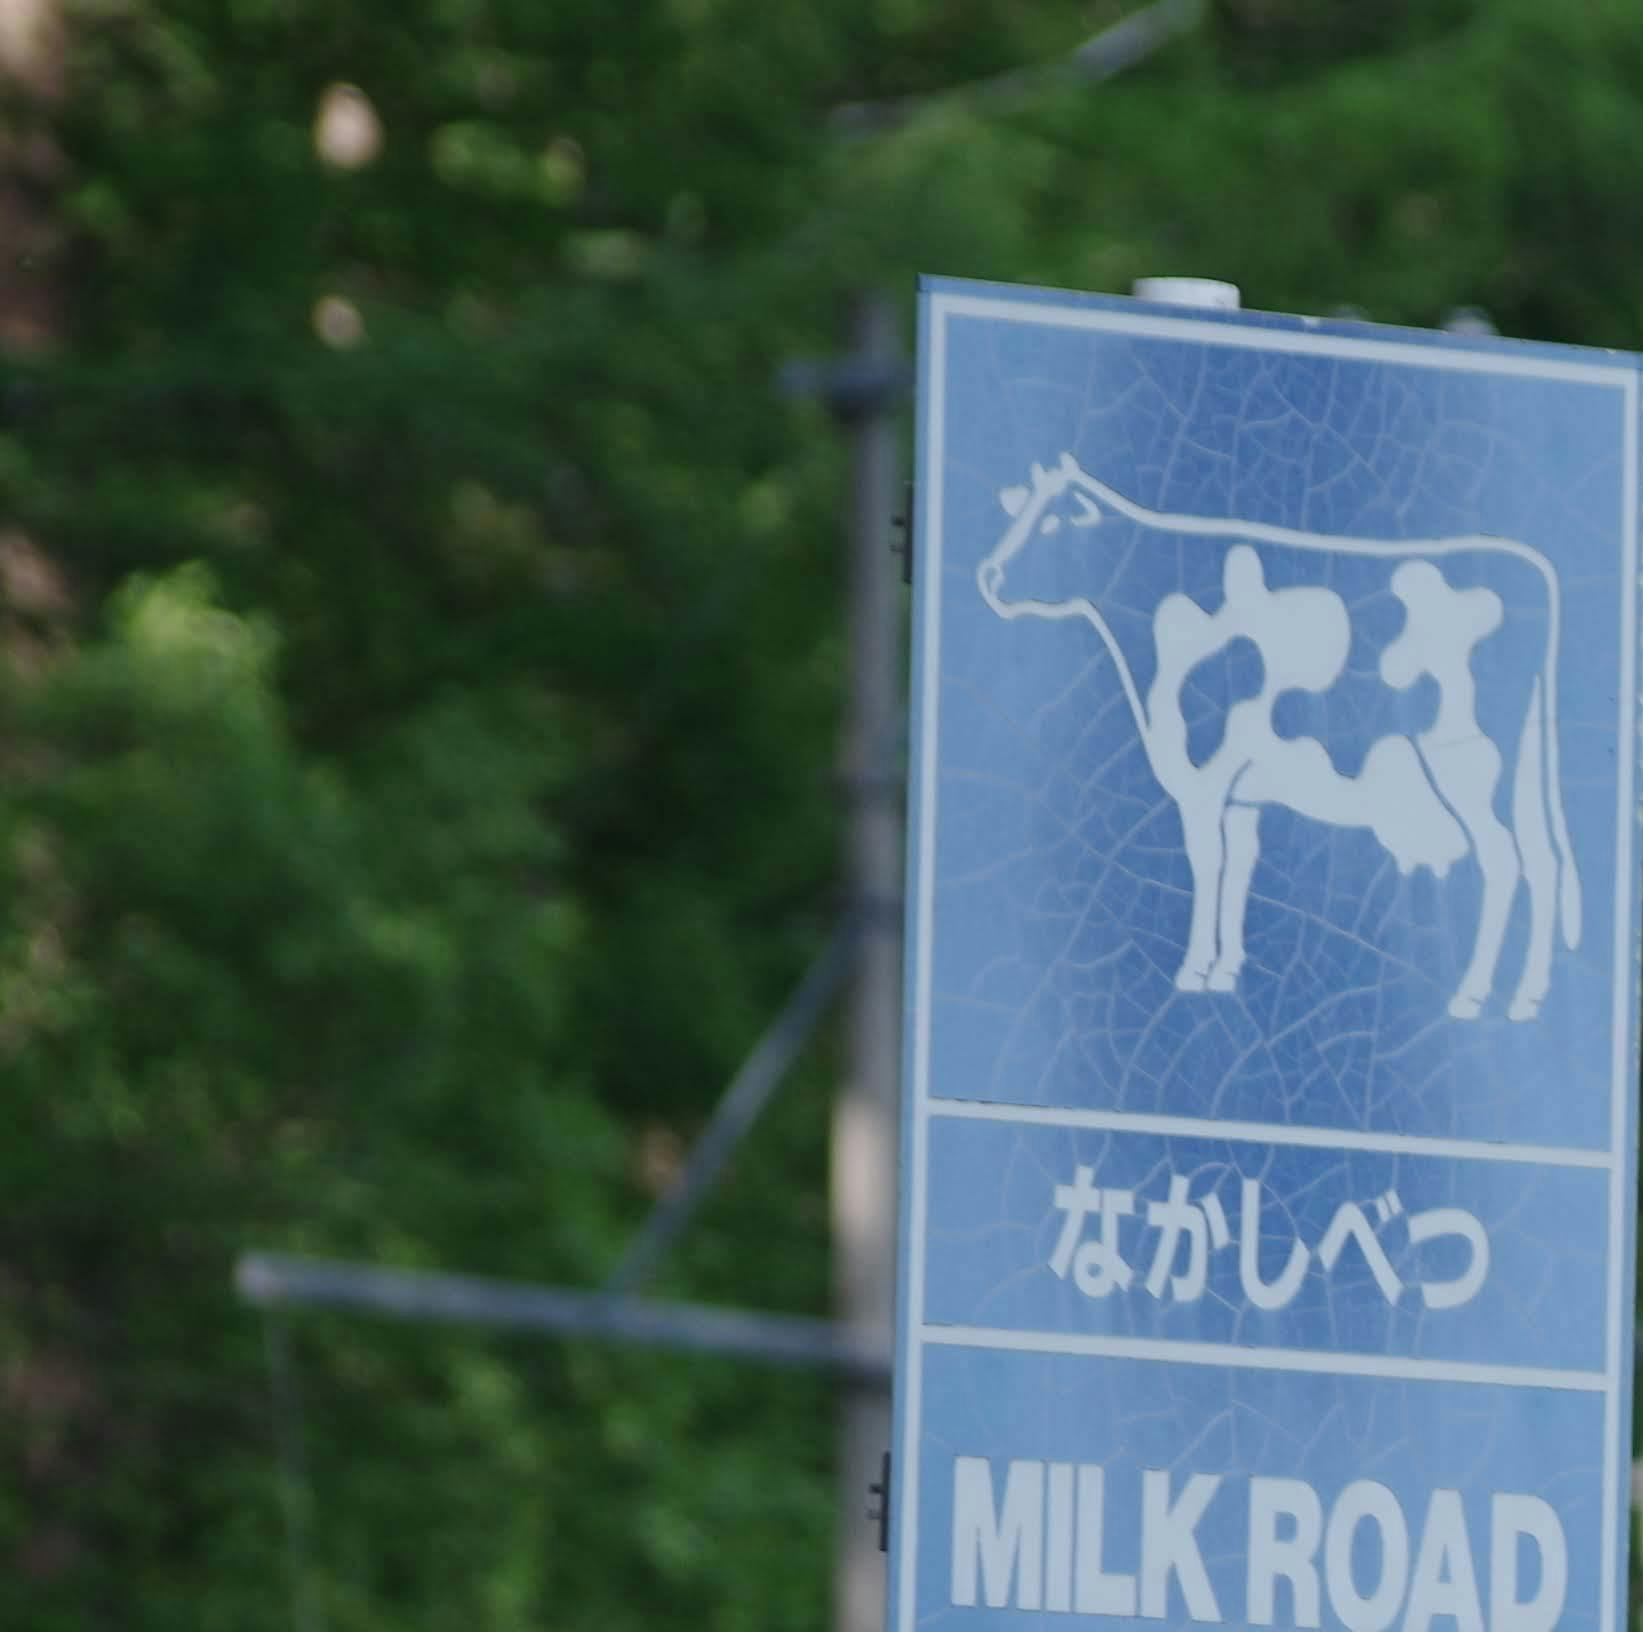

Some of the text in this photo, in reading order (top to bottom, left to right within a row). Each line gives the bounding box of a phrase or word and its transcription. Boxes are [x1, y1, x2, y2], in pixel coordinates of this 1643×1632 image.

[1050, 1167, 1489, 1309] なかしべつ
[953, 1457, 1222, 1622] MILK
